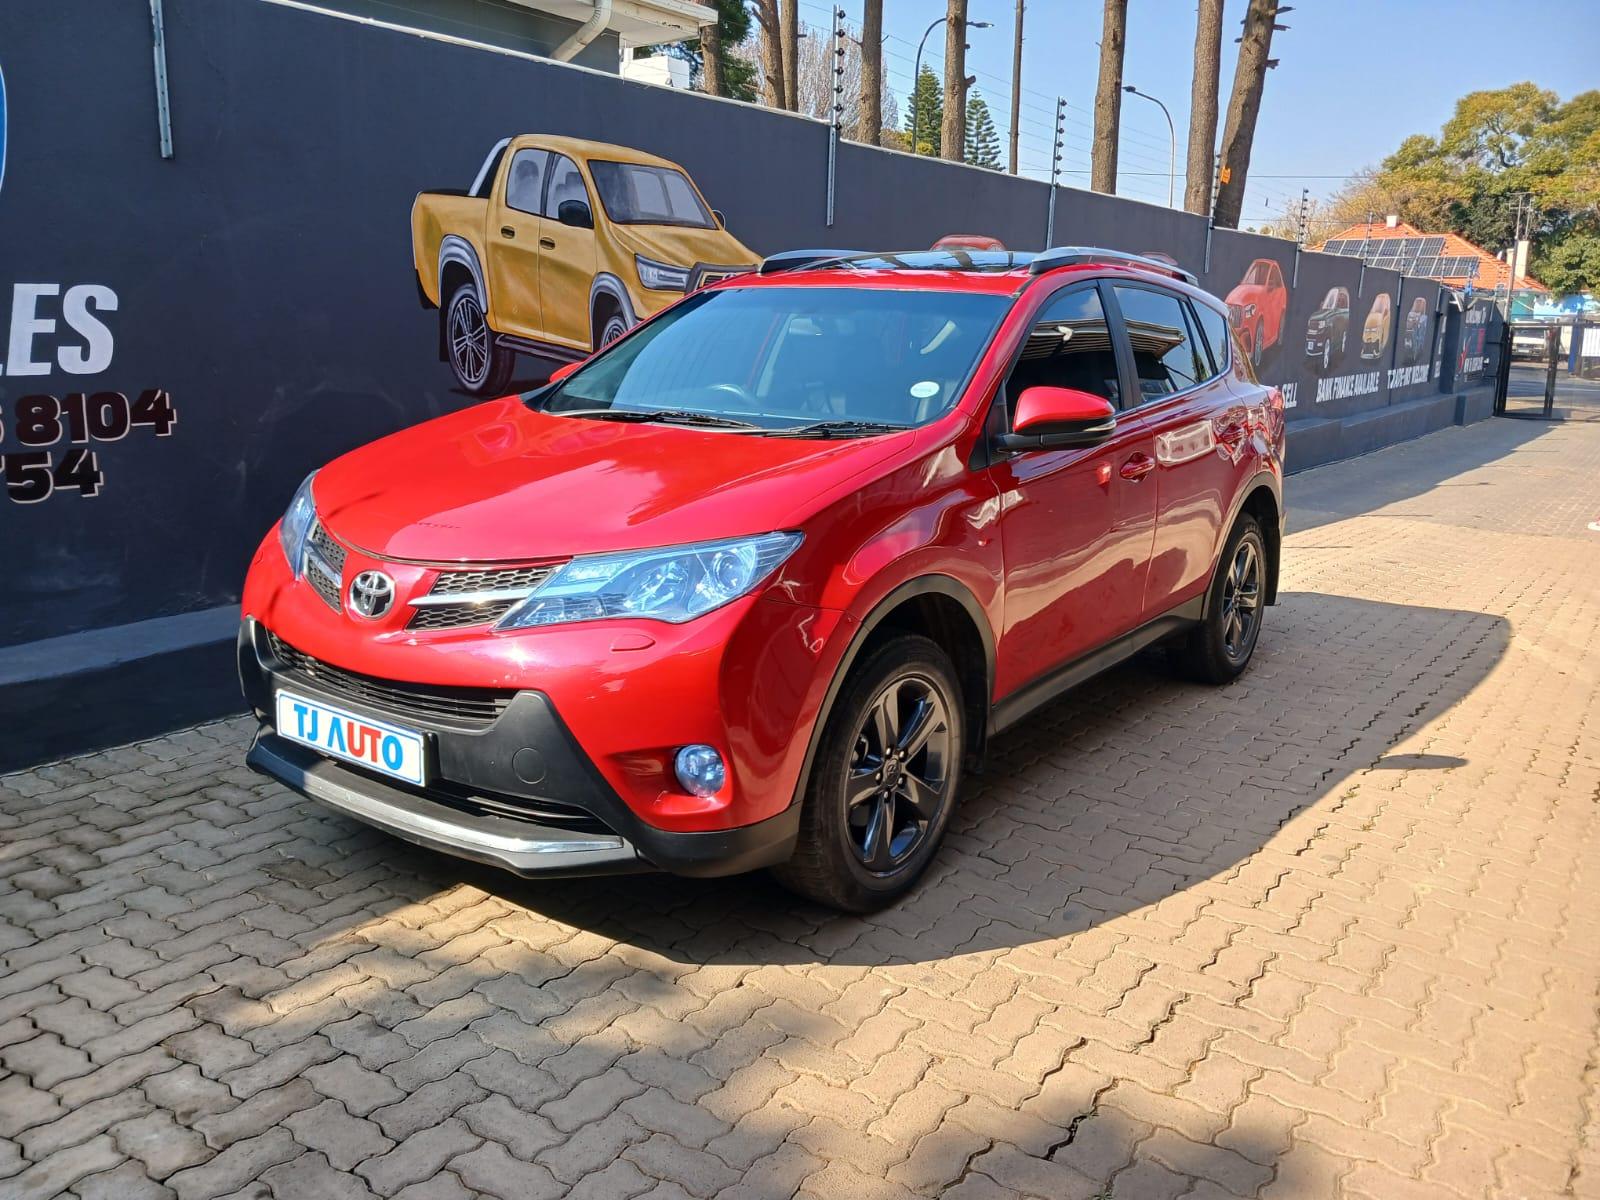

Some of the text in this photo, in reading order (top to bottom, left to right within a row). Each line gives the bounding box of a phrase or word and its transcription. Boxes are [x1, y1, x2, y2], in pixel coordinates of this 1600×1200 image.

[0, 283, 118, 376] ES
[15, 388, 178, 447] 8104
[1282, 382, 1298, 409] SELL
[0, 449, 104, 504] 54
[293, 703, 404, 771] TJ AUTO
